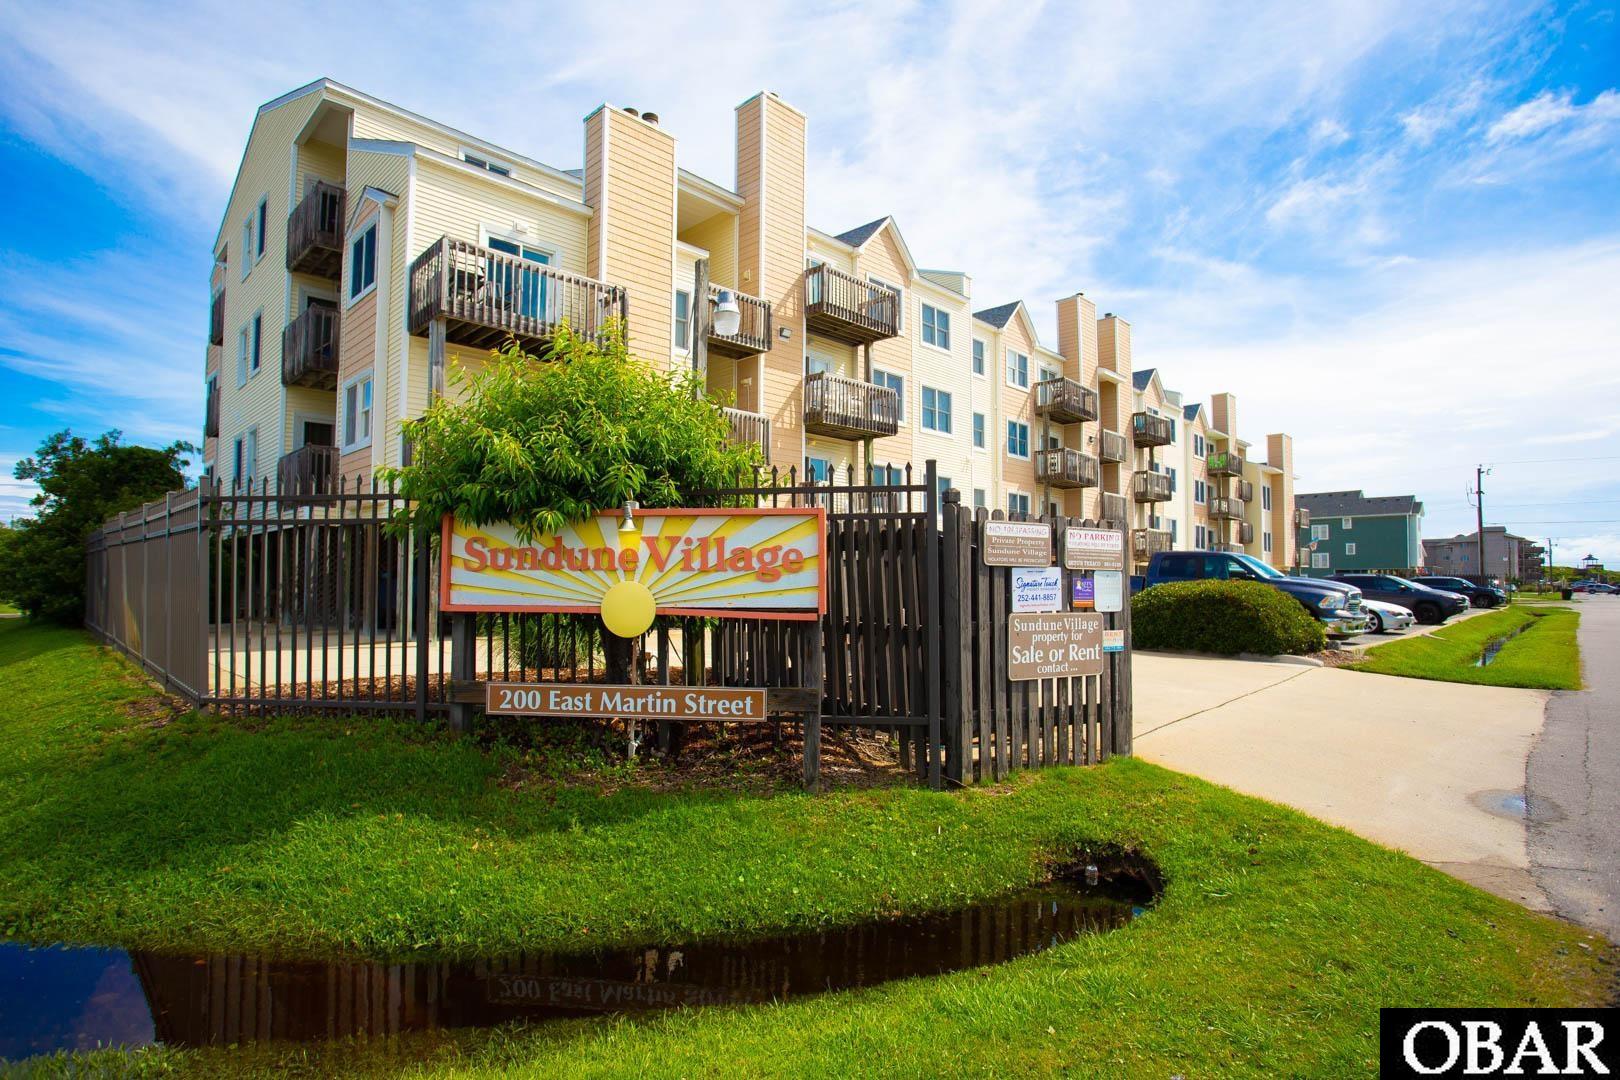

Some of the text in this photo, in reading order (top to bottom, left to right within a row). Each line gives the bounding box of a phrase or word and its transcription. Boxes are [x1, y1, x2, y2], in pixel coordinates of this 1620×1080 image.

[992, 536, 1045, 547] Private Property
[1069, 532, 1120, 542] NO PARKING
[463, 536, 805, 583] Sundune Village
[988, 547, 1048, 557] Sundune Village
[1017, 593, 1057, 602] 252-441-8857
[1014, 617, 1099, 633] Sundune Village
[1032, 630, 1083, 645] property for
[1012, 643, 1101, 664] Sale or Rent
[499, 689, 754, 716] 200 East Martin Street
